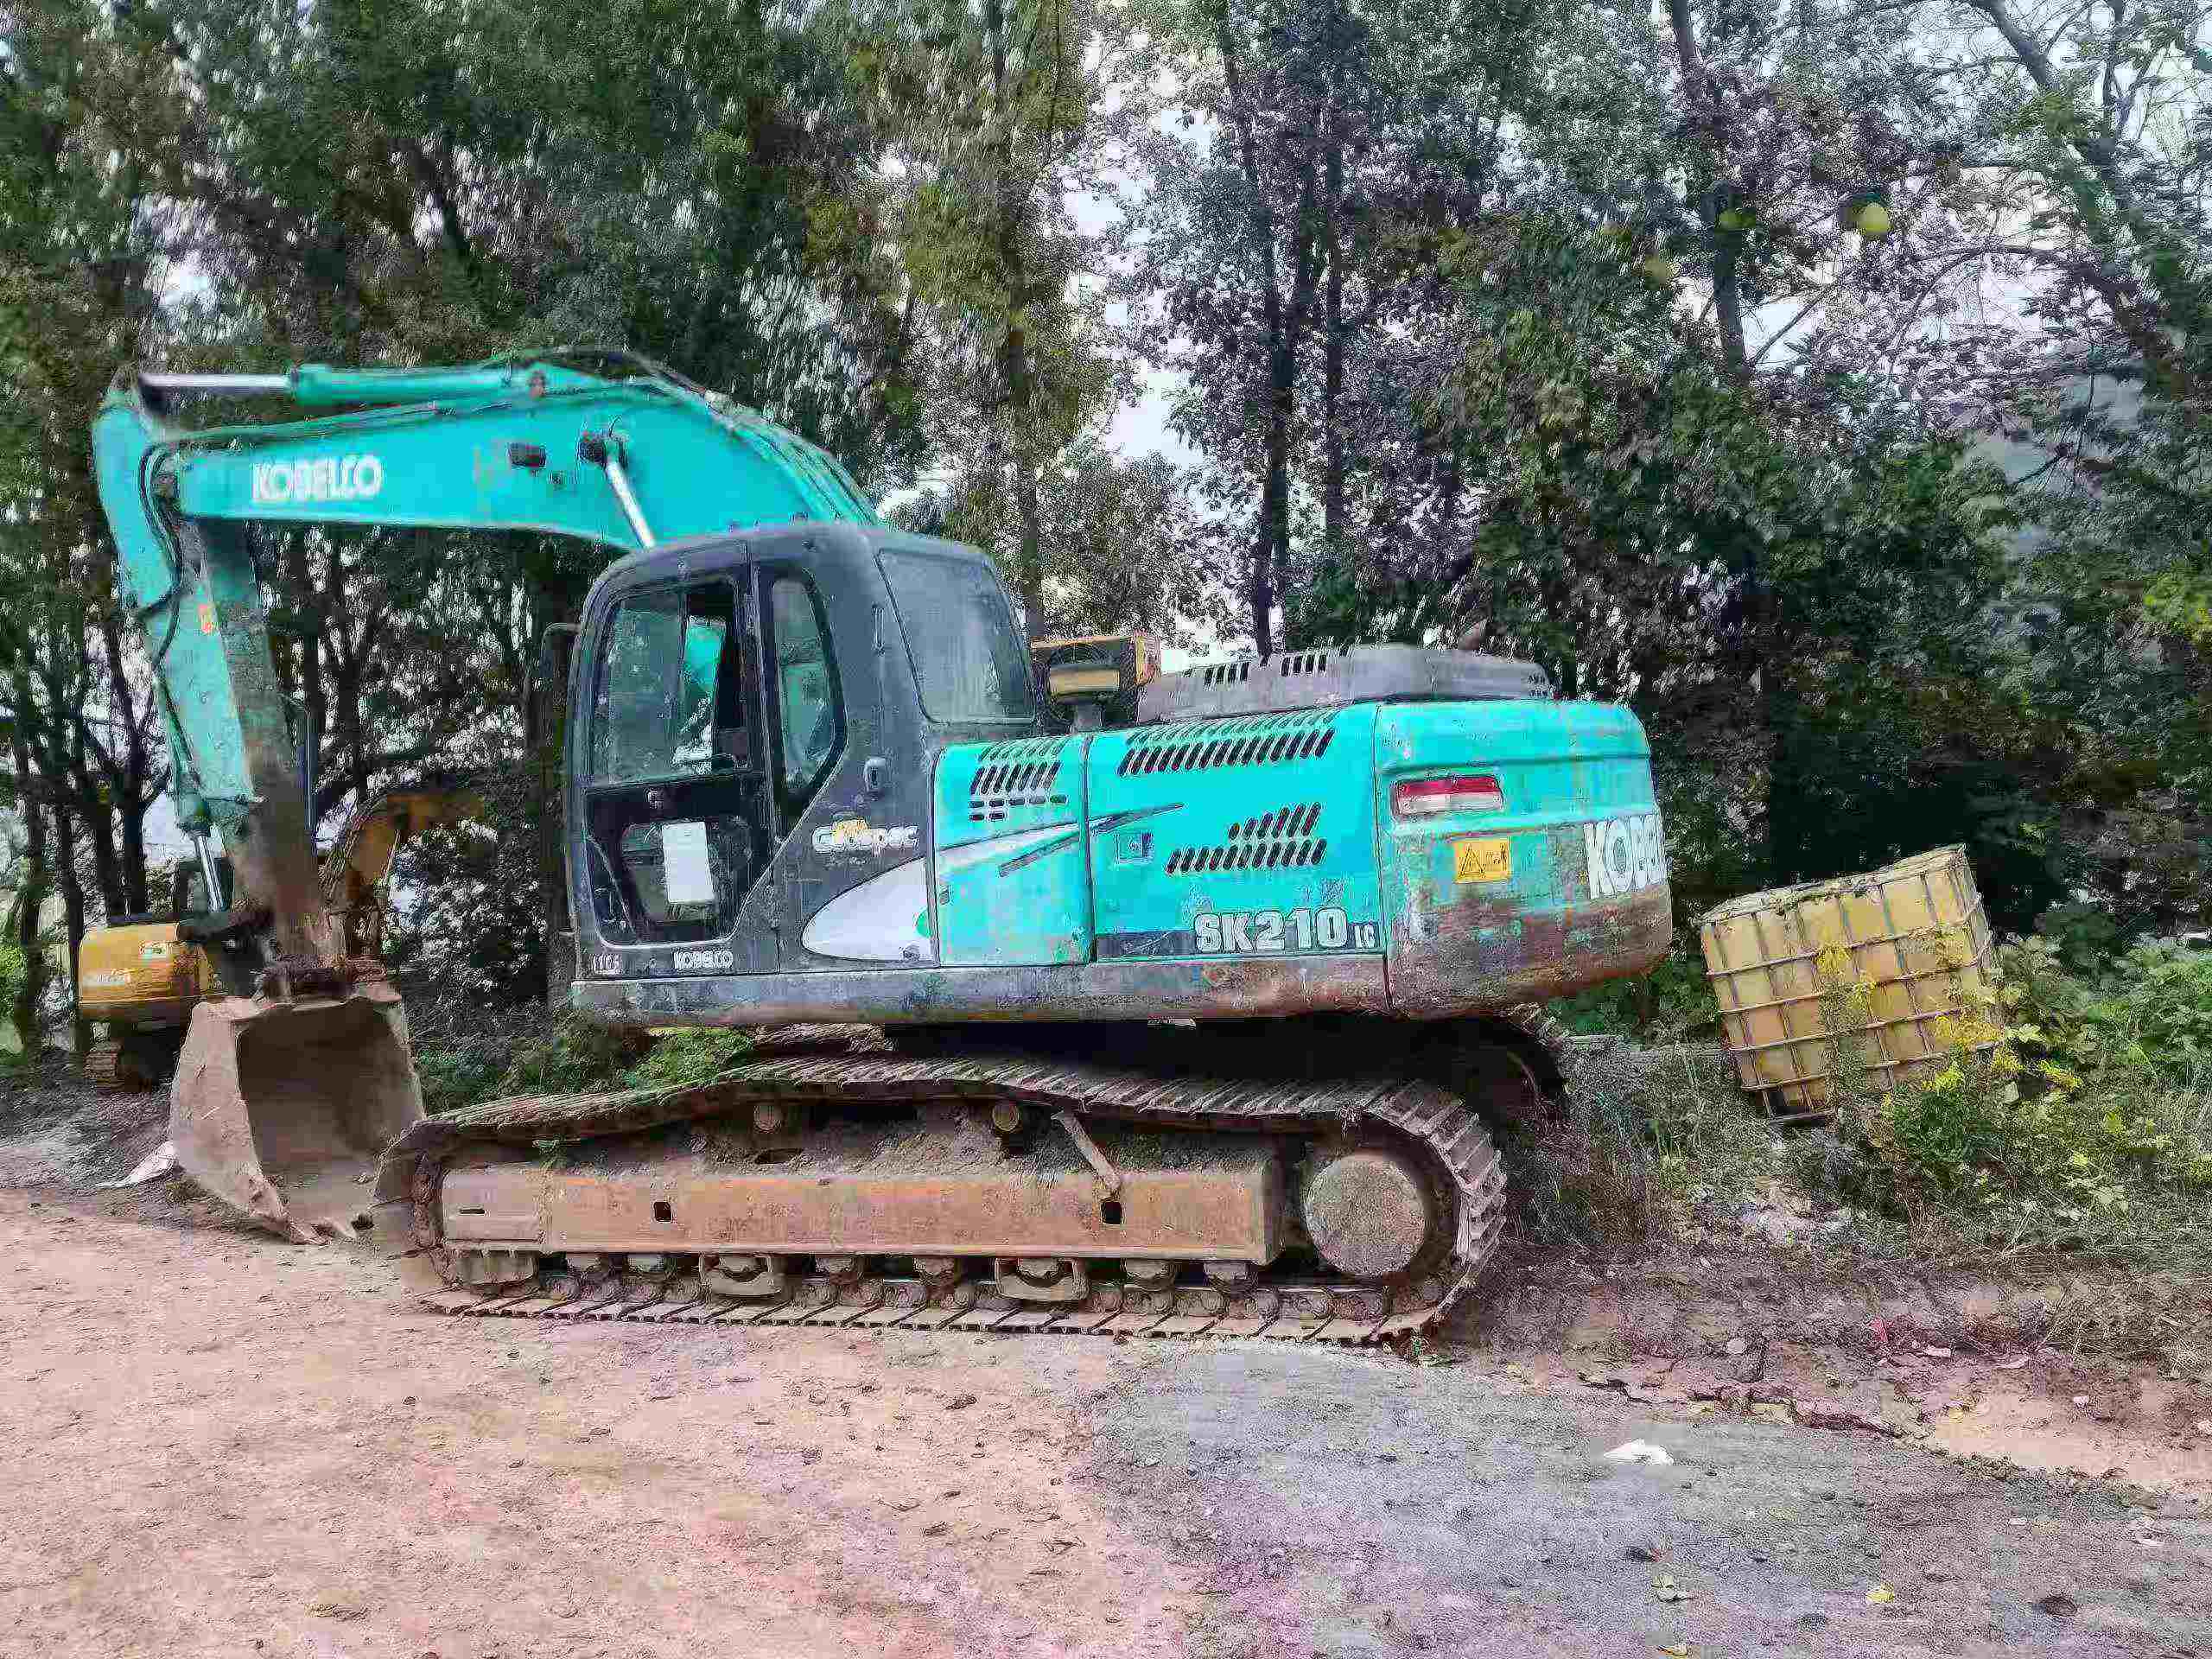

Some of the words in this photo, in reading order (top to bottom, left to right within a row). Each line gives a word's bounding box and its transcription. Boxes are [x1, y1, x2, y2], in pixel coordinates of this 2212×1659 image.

[251, 454, 383, 499] KOBELCO
[1193, 907, 1348, 951] SK210
[1355, 923, 1376, 949] LC
[673, 950, 734, 970] KOBELCO
